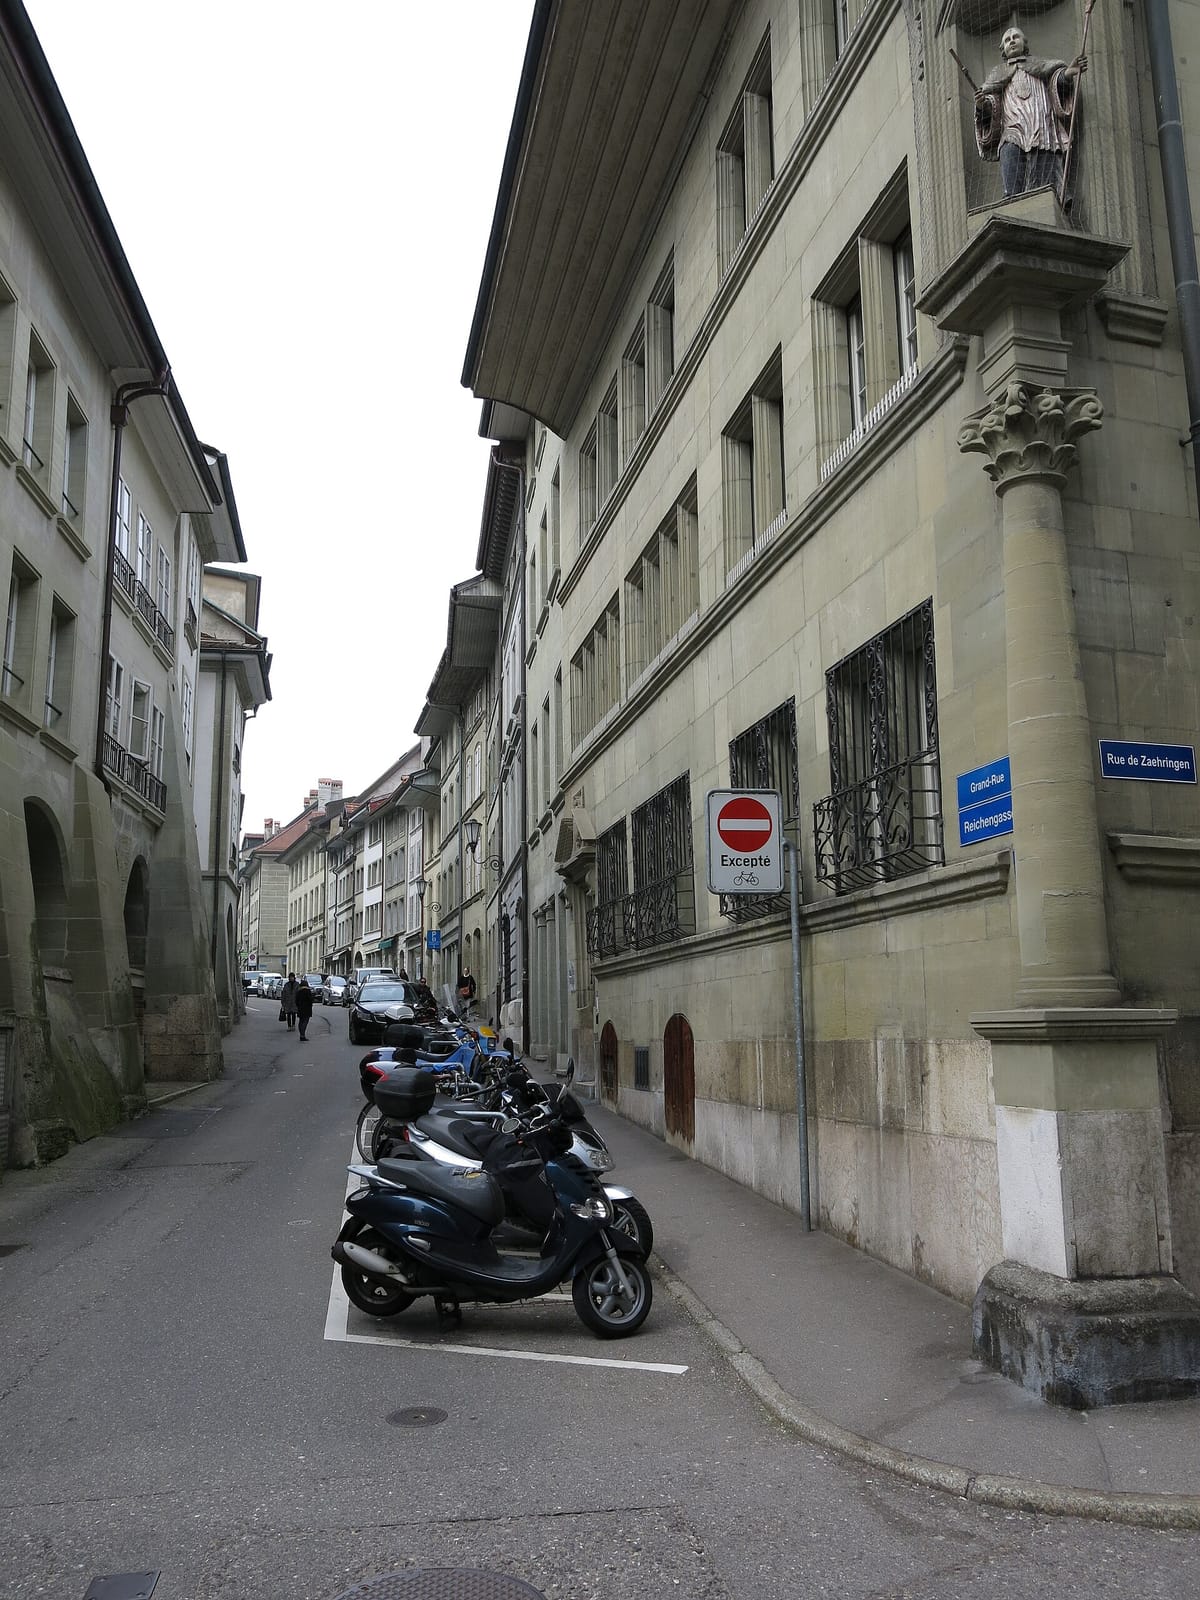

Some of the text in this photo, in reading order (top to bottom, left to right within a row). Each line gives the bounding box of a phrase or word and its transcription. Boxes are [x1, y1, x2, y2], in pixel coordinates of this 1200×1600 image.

[1107, 753, 1190, 771] Rue de Zaehringen
[970, 773, 1005, 793] Grand-Rue
[964, 810, 1013, 833] Reichengass
[721, 855, 771, 868] Excepté
